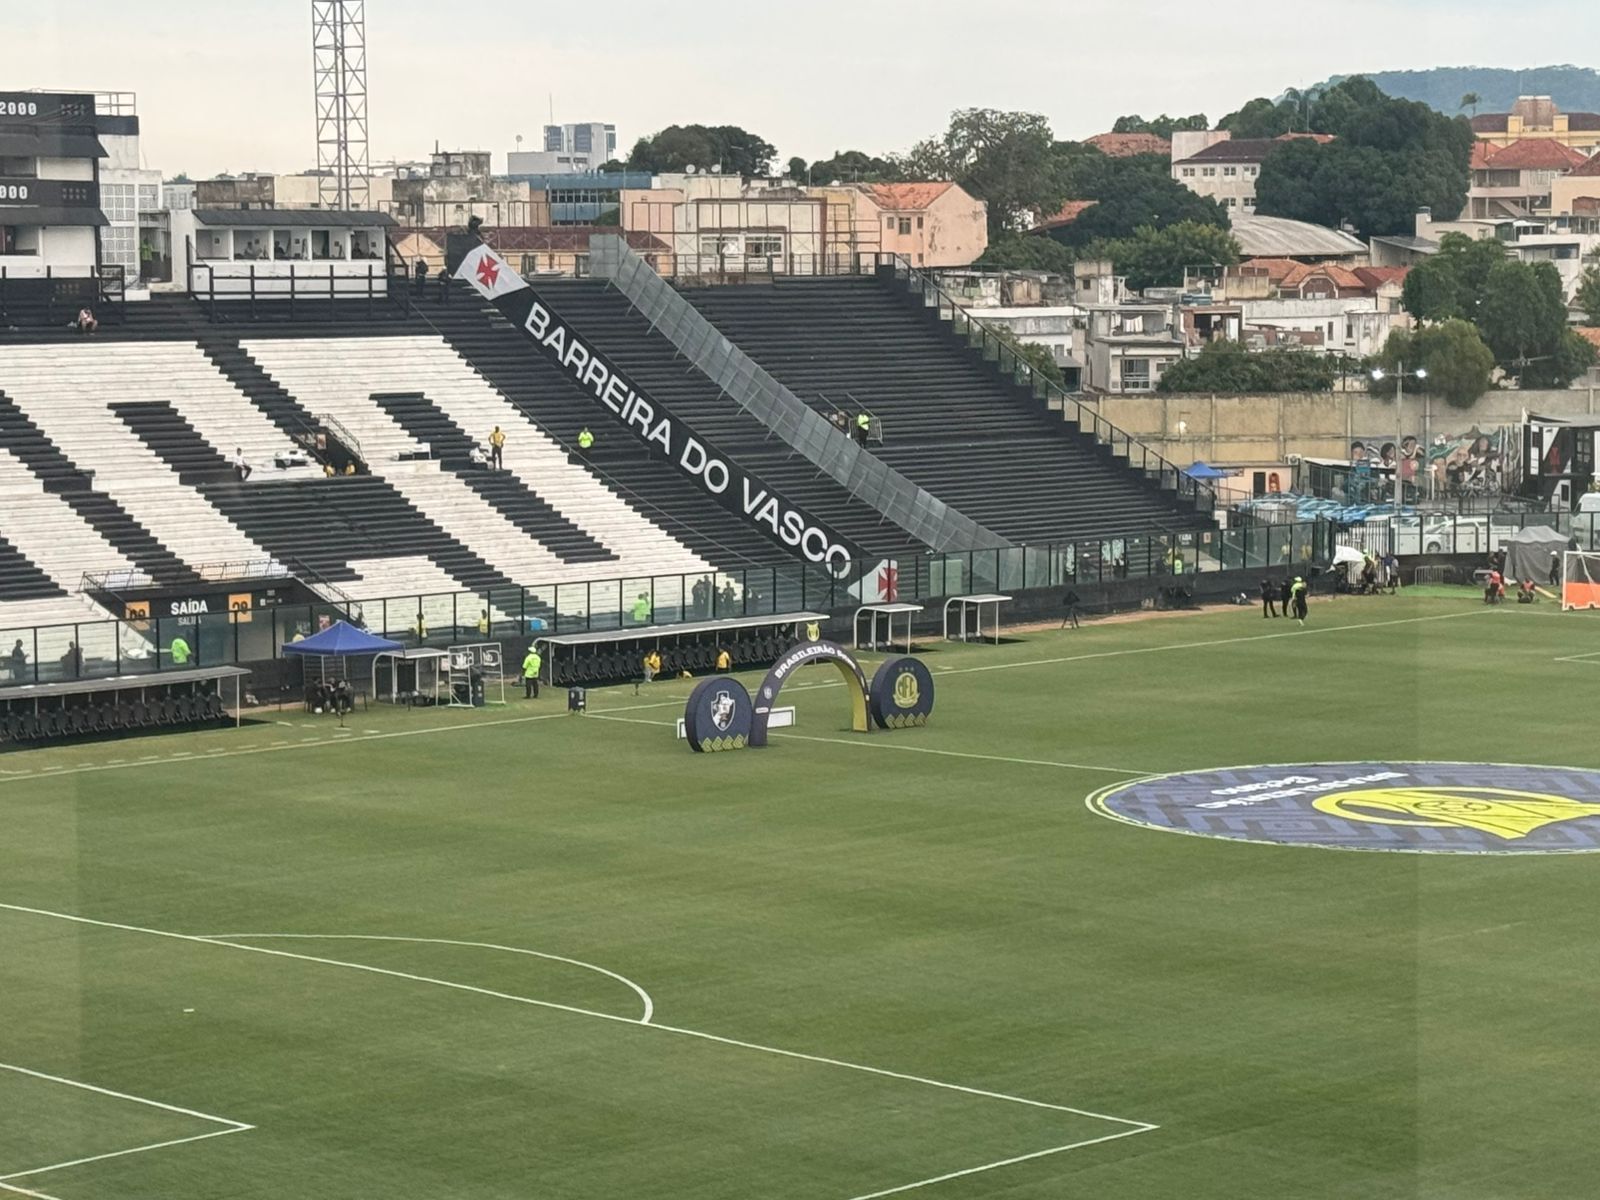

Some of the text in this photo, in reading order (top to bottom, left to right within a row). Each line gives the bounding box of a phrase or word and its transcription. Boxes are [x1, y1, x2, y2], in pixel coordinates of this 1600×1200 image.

[525, 302, 851, 579] BARREIRA DO VASCO
[171, 598, 208, 615] SAÍDA
